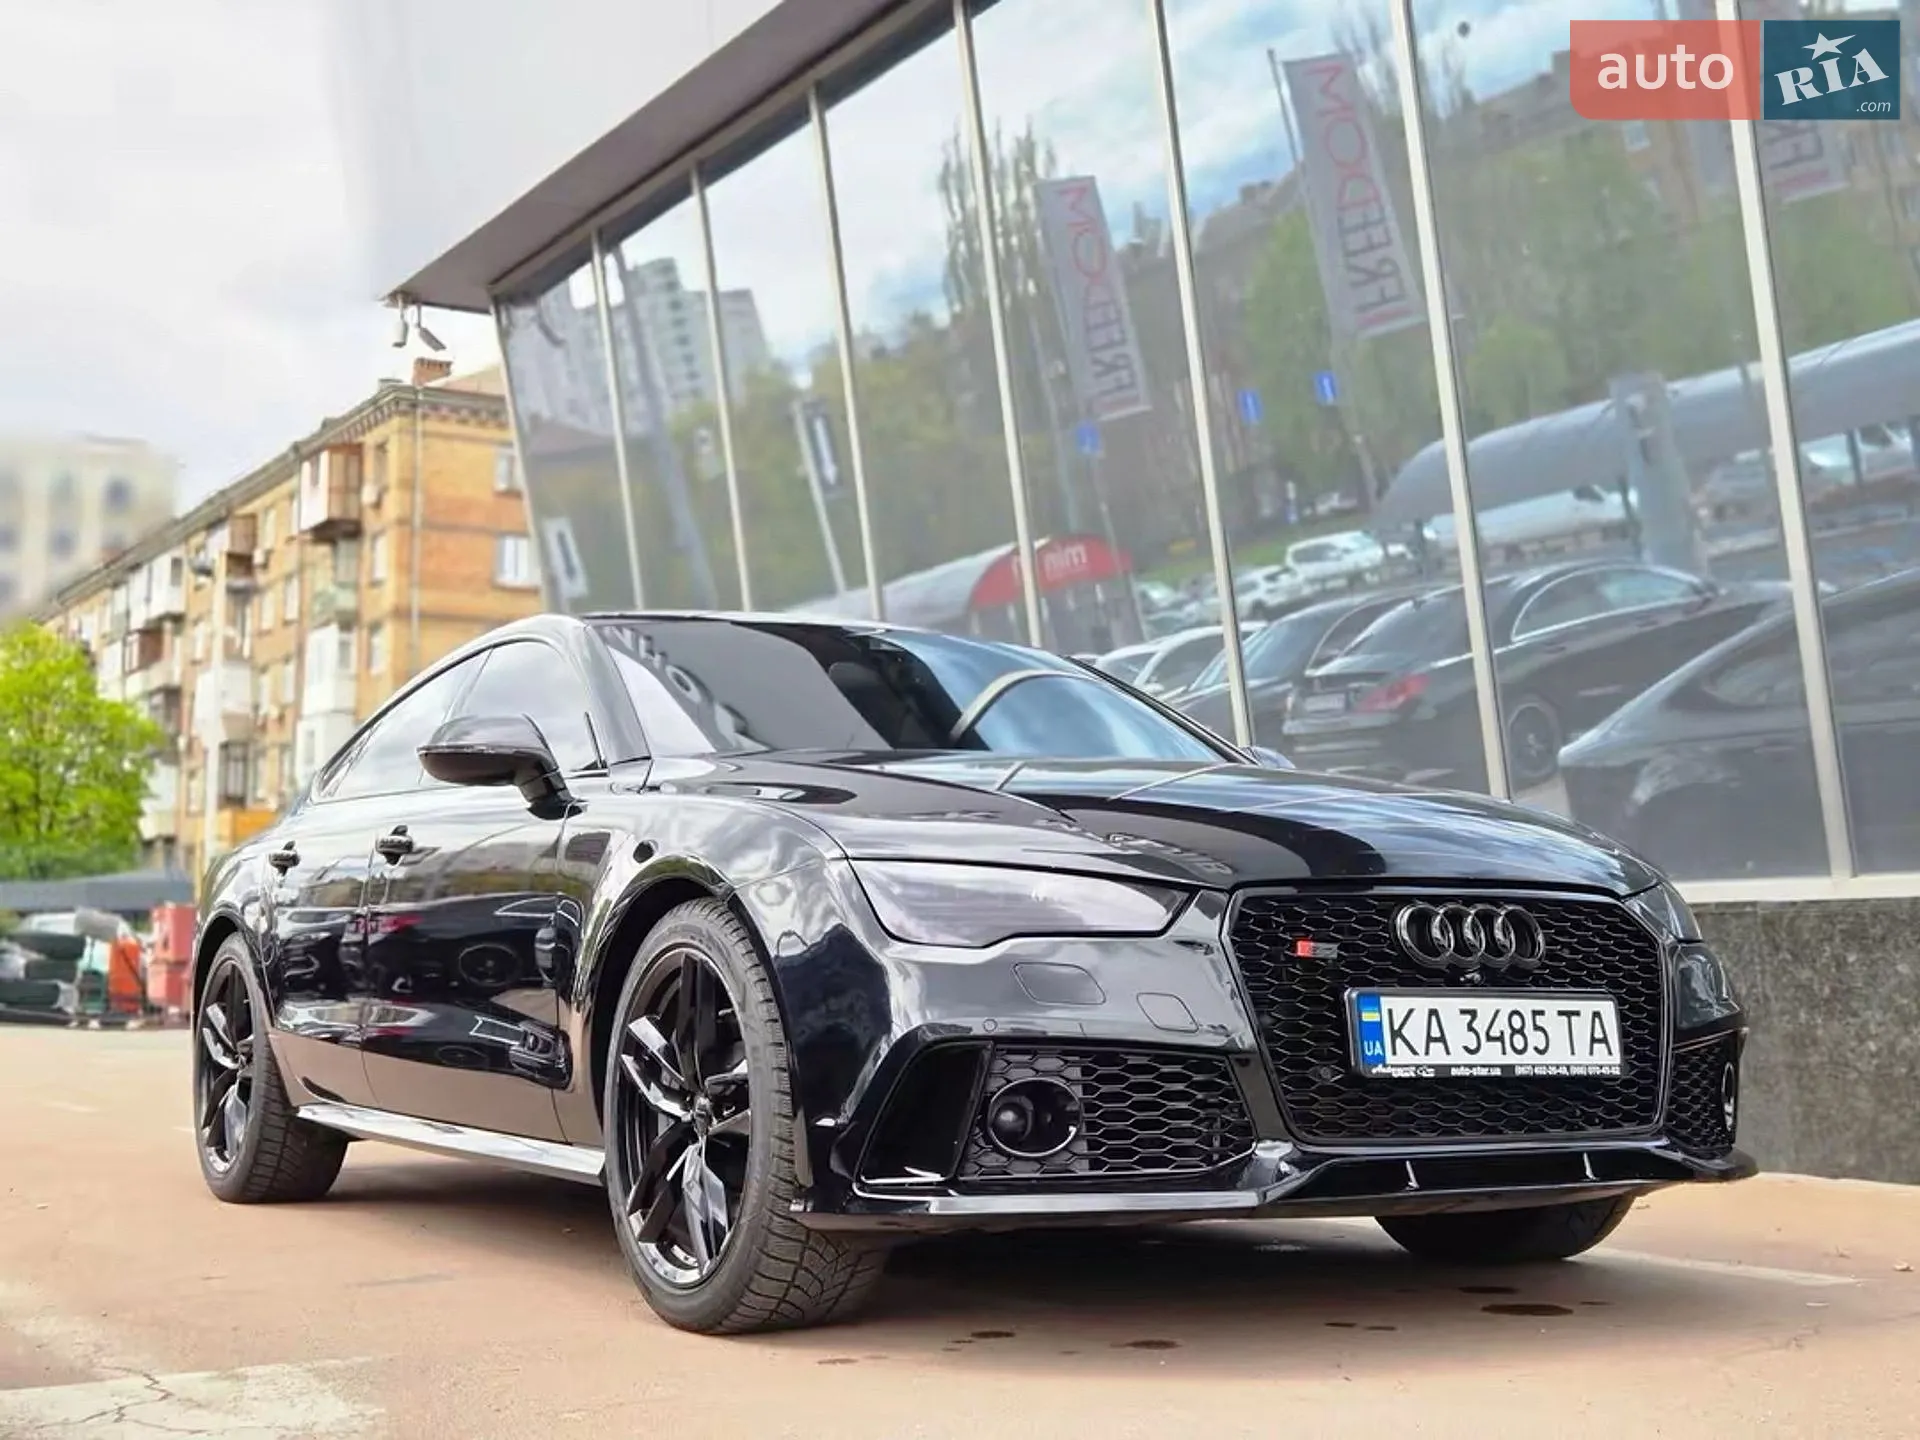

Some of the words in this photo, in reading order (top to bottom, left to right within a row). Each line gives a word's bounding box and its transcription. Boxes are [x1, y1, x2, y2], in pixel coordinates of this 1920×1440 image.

[1386, 1007, 1452, 1056] KA
[1458, 1007, 1550, 1057] 3485
[1556, 1009, 1614, 1057] TA
[1363, 1041, 1384, 1057] UA
